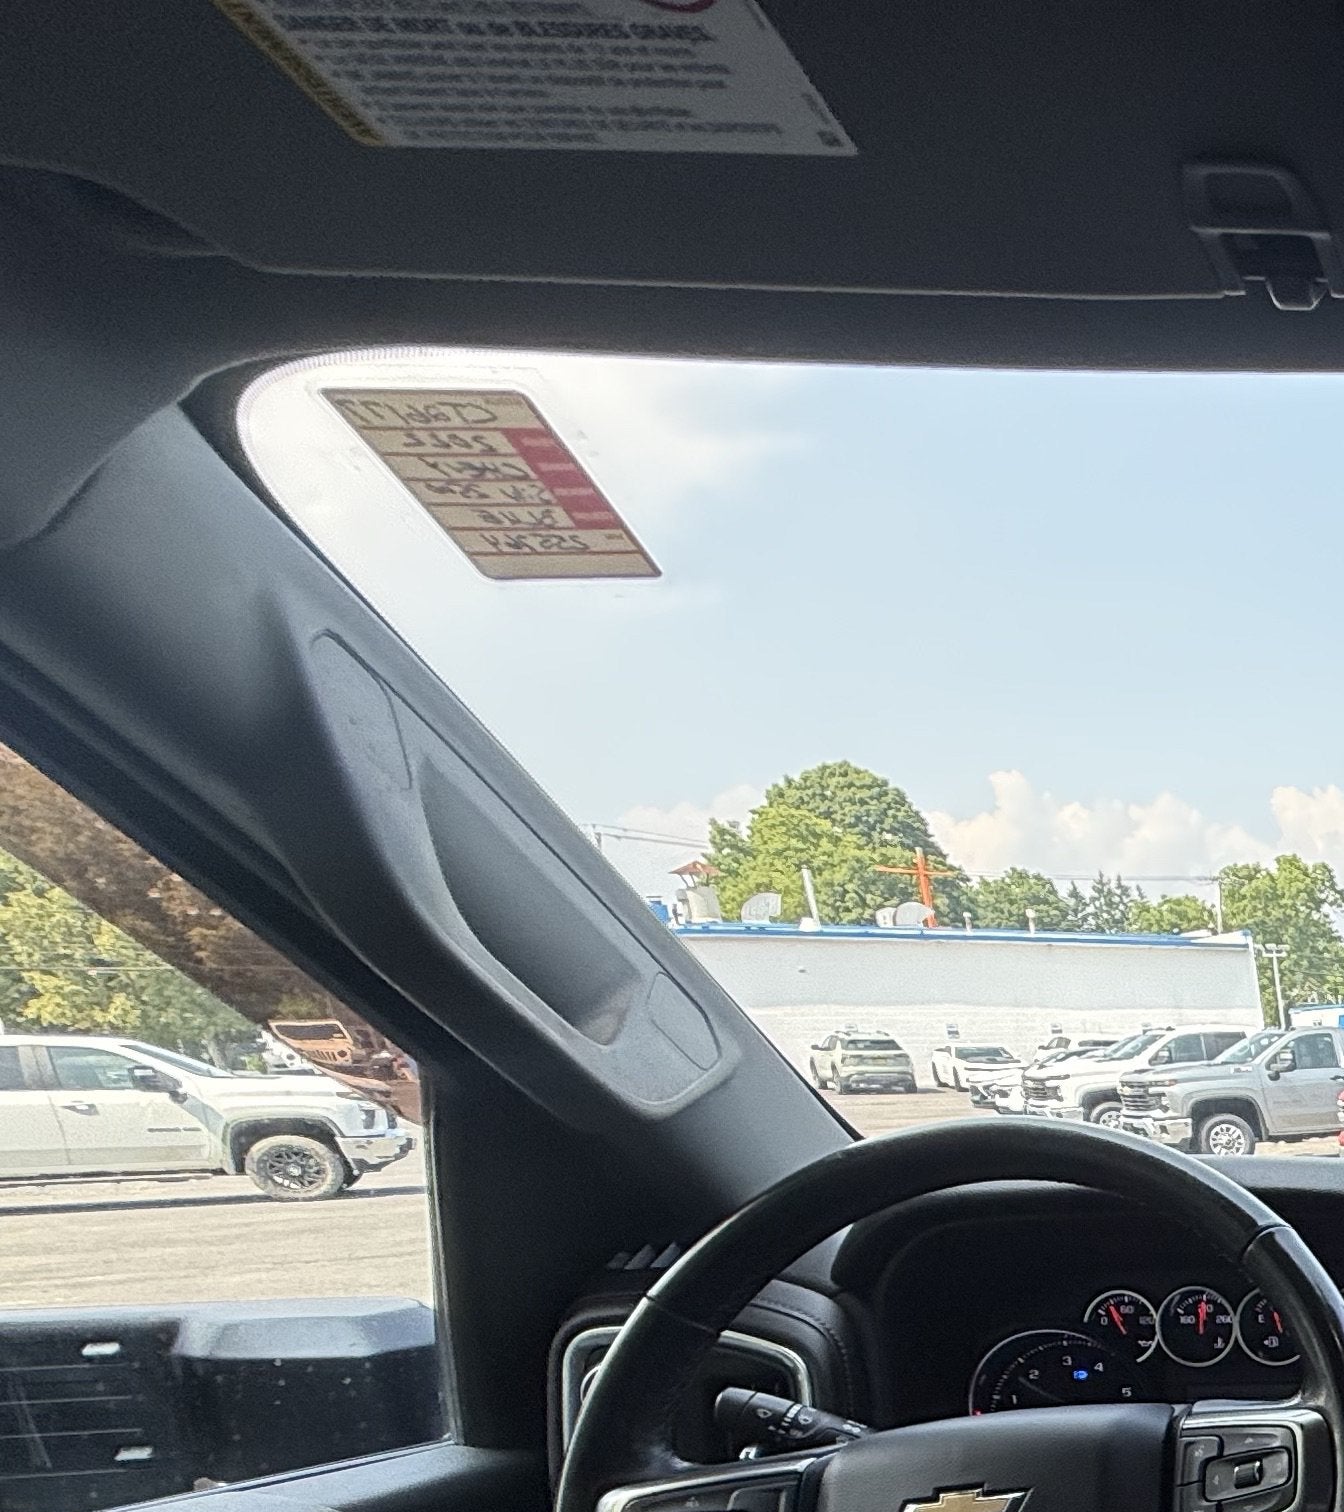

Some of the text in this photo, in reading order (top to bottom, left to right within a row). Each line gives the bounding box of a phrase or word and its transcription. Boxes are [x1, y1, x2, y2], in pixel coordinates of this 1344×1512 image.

[1258, 1315, 1265, 1324] E
[1062, 1356, 1072, 1366] 3
[1094, 1362, 1104, 1372] 4
[1029, 1369, 1039, 1379] 2
[1121, 1387, 1131, 1397] 5
[1012, 1394, 1018, 1404] 1
